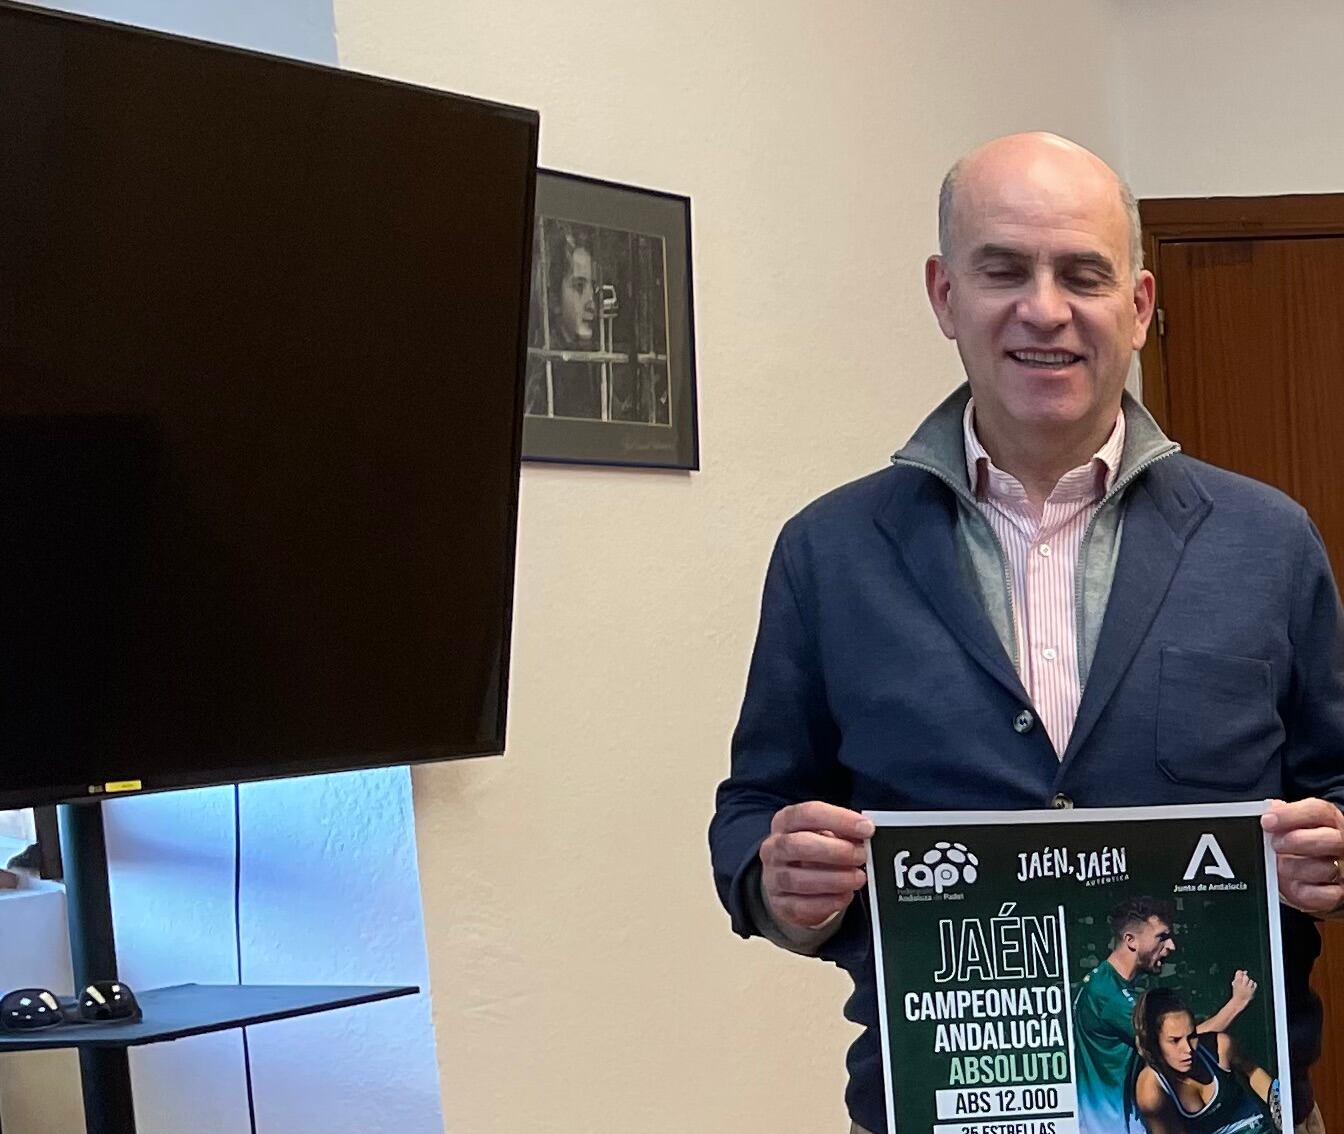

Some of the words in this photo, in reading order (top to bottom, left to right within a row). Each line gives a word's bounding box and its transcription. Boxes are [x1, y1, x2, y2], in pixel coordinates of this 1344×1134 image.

[894, 850, 959, 893] fap
[1016, 846, 1075, 882] JAÉN,
[1075, 846, 1128, 881] JAÉN
[934, 902, 1060, 983] JAÉN
[904, 985, 1063, 1021] CAMPEONATO
[934, 1013, 1065, 1053] ANDALUCÍA
[949, 1051, 1068, 1086] ABSOLUTO
[955, 1089, 992, 1115] ABS
[994, 1087, 1059, 1113] 12.000
